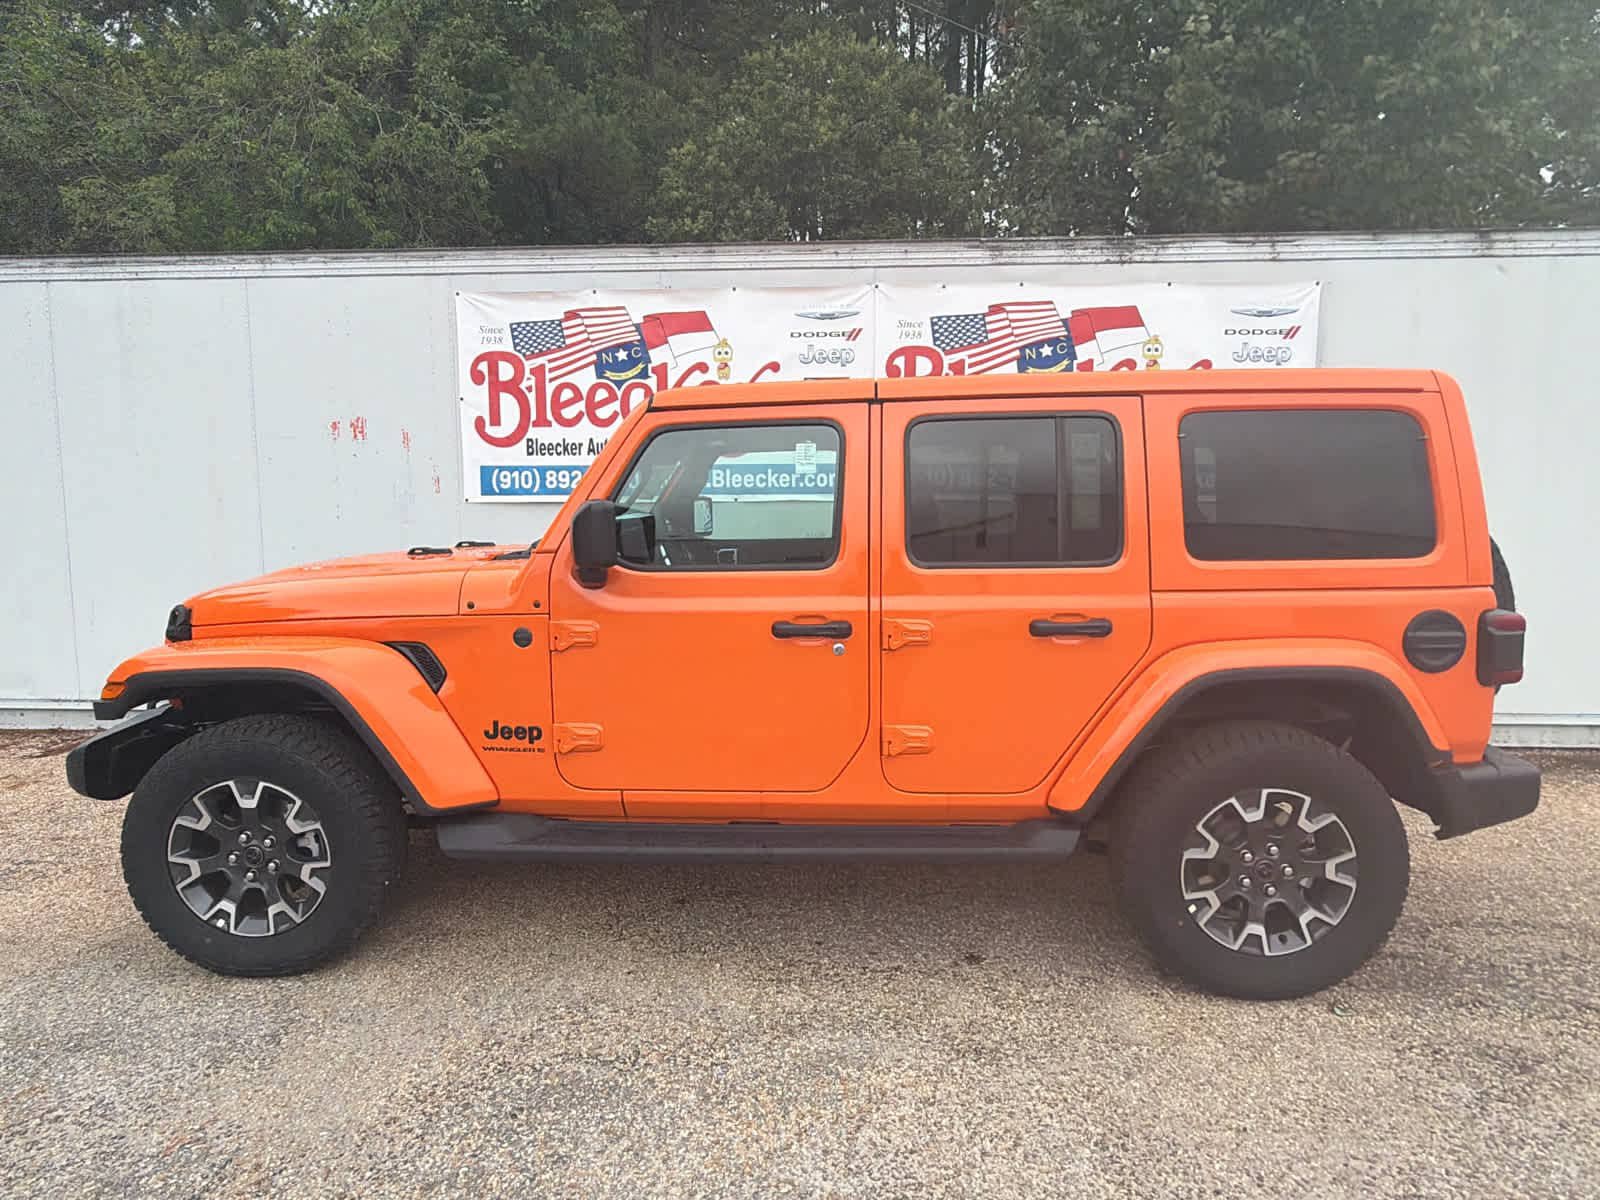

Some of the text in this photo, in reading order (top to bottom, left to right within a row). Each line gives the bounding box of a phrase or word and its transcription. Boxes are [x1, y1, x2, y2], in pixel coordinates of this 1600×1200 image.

[479, 325, 504, 335] Since
[896, 319, 923, 329] Since
[1224, 328, 1290, 336] DODGE
[480, 335, 504, 345] 1938
[899, 329, 923, 340] 1938
[601, 346, 642, 364] N C
[799, 344, 855, 367] Jeep
[1025, 343, 1068, 361] N C
[1231, 341, 1292, 366] Jeep
[470, 351, 780, 447] Bleec
[526, 437, 584, 456] Bleecker
[492, 468, 540, 493] (910)
[483, 719, 543, 745] Jeep
